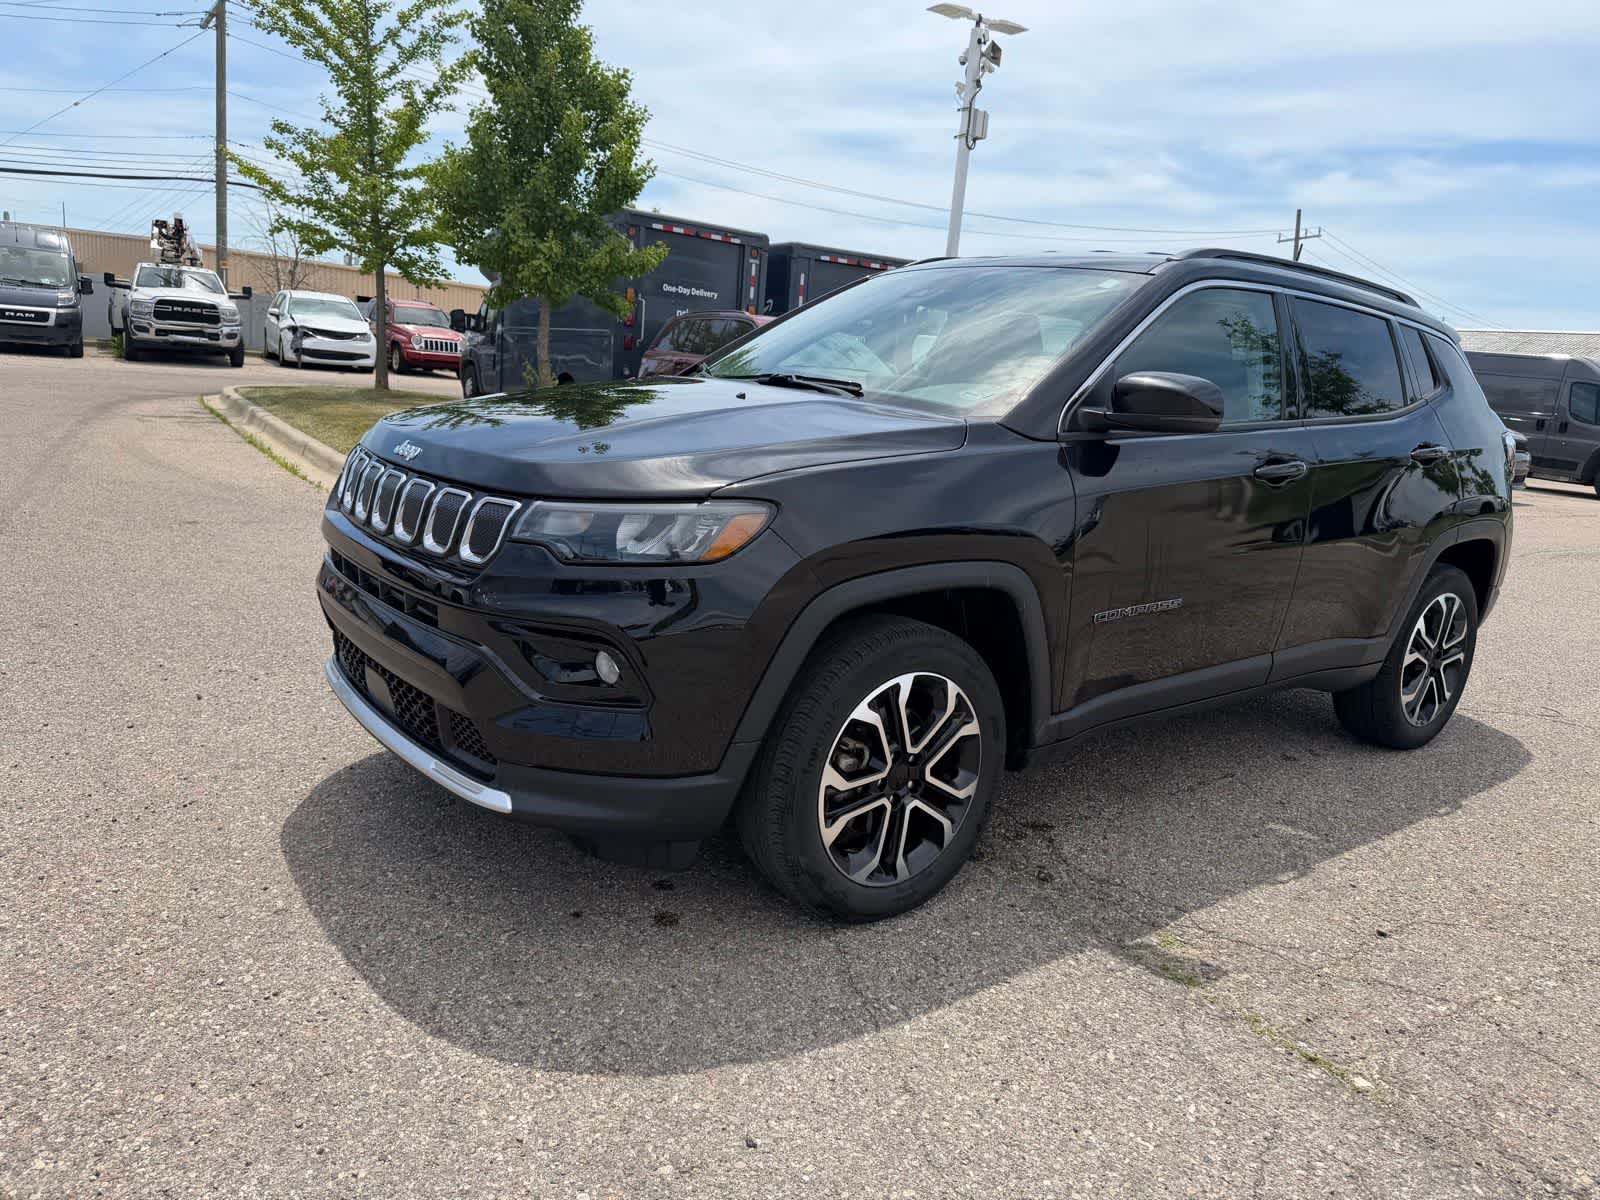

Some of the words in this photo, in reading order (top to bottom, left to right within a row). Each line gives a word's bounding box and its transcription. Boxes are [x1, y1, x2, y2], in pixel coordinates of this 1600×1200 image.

[662, 283, 691, 296] One-Day
[691, 287, 719, 300] Delivery
[173, 305, 202, 313] RAM
[393, 440, 422, 461] Jeep
[1093, 598, 1183, 624] COMPASS
